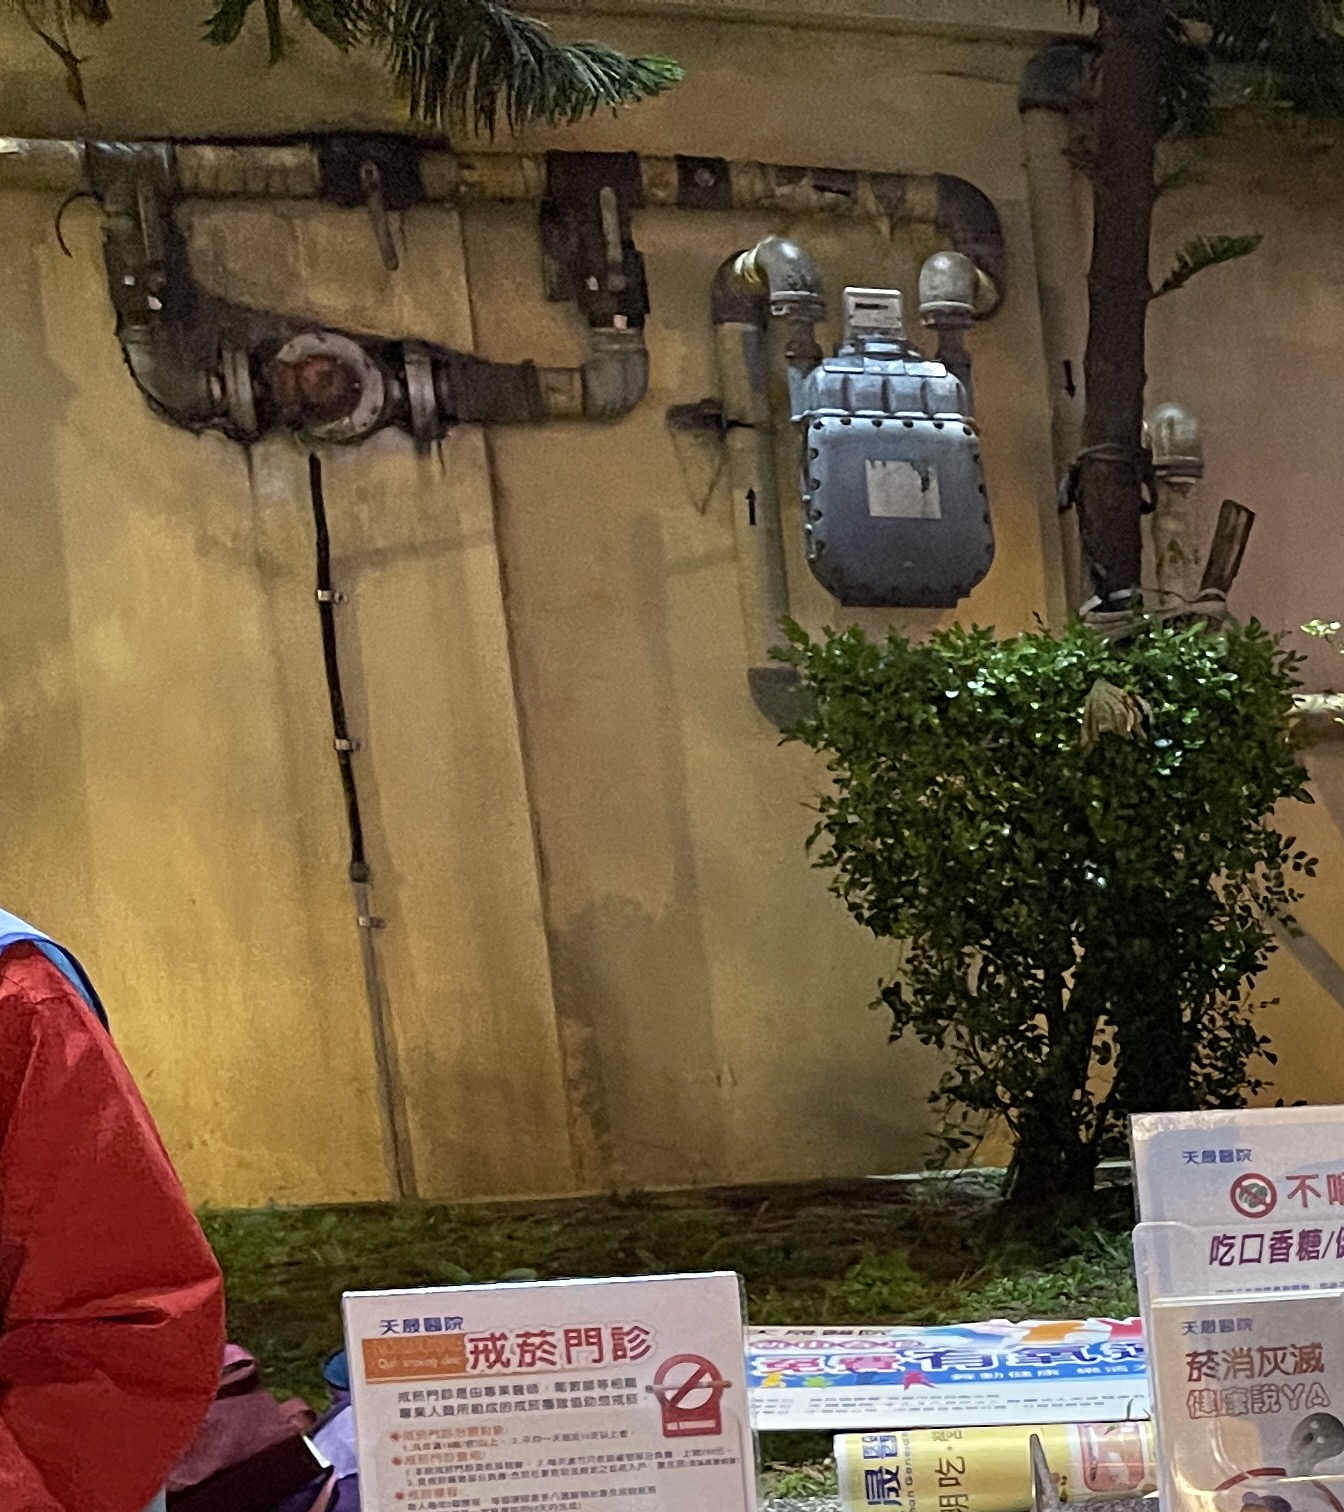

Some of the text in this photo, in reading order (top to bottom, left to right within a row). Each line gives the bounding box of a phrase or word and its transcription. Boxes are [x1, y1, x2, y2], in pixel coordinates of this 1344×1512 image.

[467, 1324, 652, 1371] 戒菸門診
[1186, 1342, 1325, 1382] 菸消灰滅
